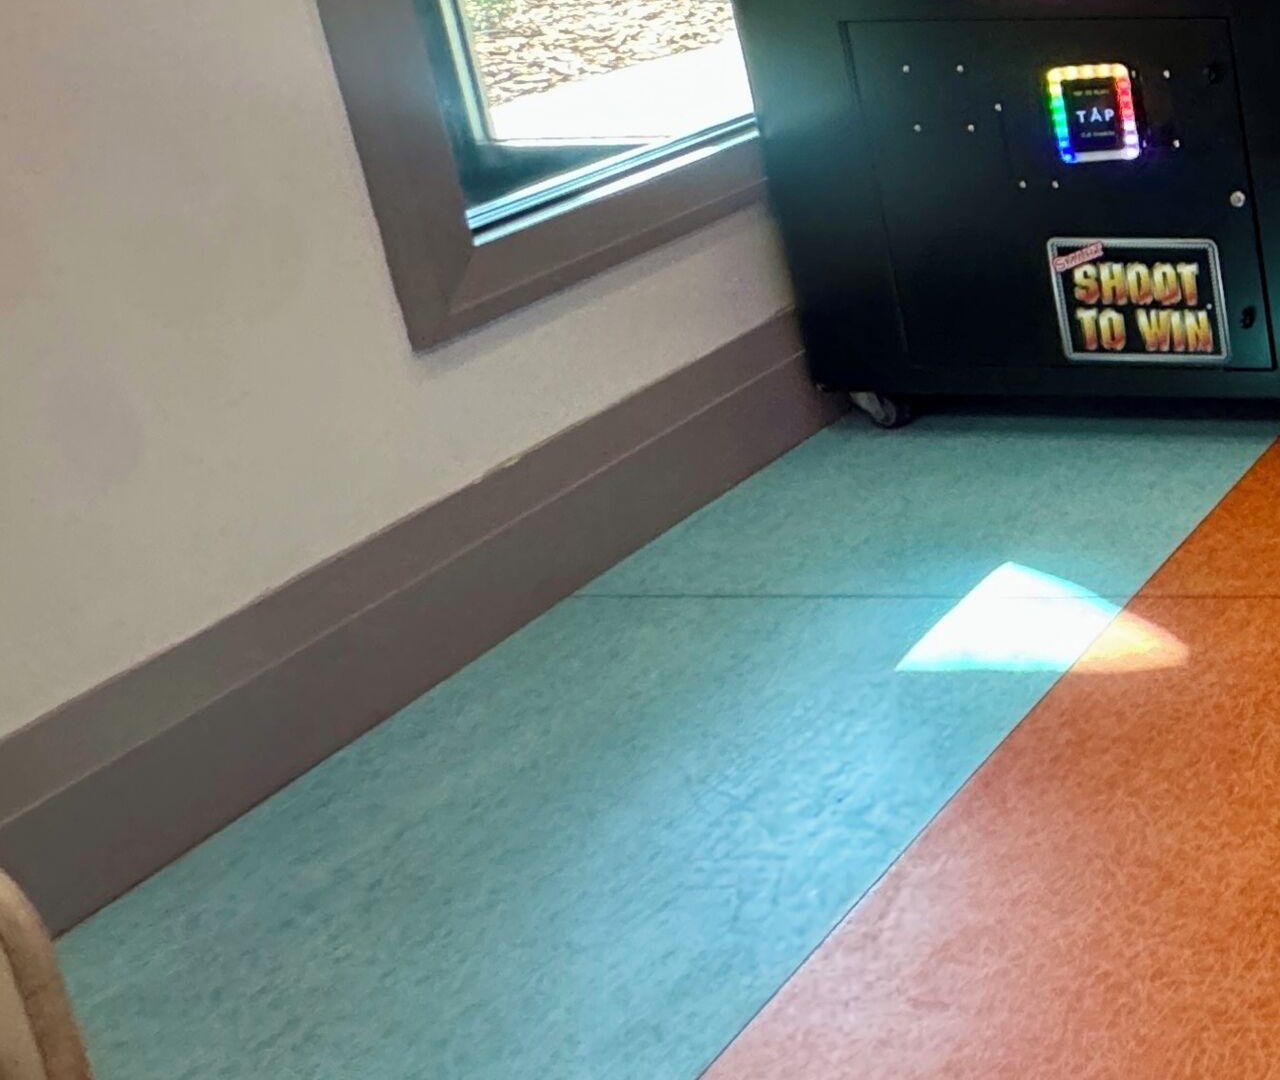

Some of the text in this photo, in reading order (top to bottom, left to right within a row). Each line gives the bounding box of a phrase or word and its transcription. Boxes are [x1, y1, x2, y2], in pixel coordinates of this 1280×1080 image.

[1076, 107, 1115, 123] TAP
[1073, 262, 1200, 306] SHOOT
[1075, 307, 1213, 352] TO WIN
